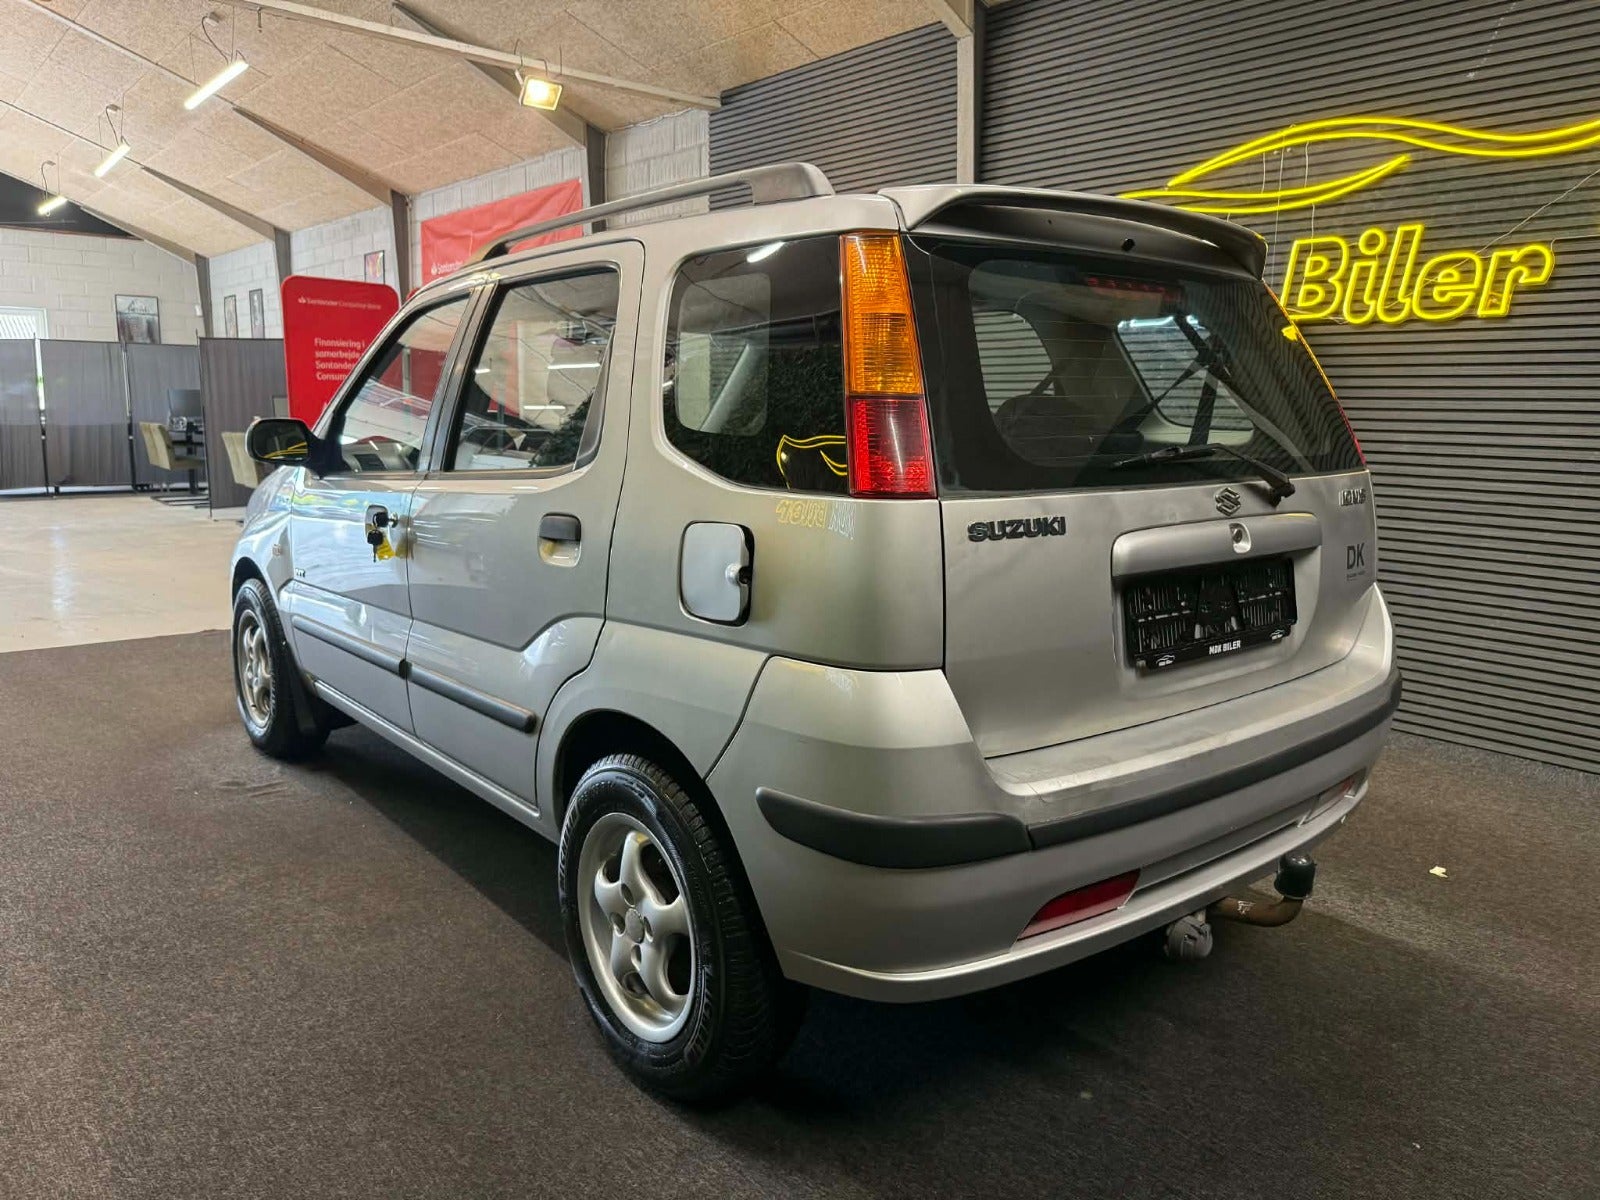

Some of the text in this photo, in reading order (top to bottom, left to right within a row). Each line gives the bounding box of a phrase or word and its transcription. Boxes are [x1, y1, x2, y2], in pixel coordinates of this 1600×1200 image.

[1281, 225, 1555, 324] Biler
[314, 337, 361, 350] Finansiering
[315, 350, 360, 360] samarbejde
[316, 371, 347, 381] Consum
[968, 516, 1067, 542] SUZUKI
[1346, 542, 1365, 570] DK
[1222, 639, 1241, 652] BILER
